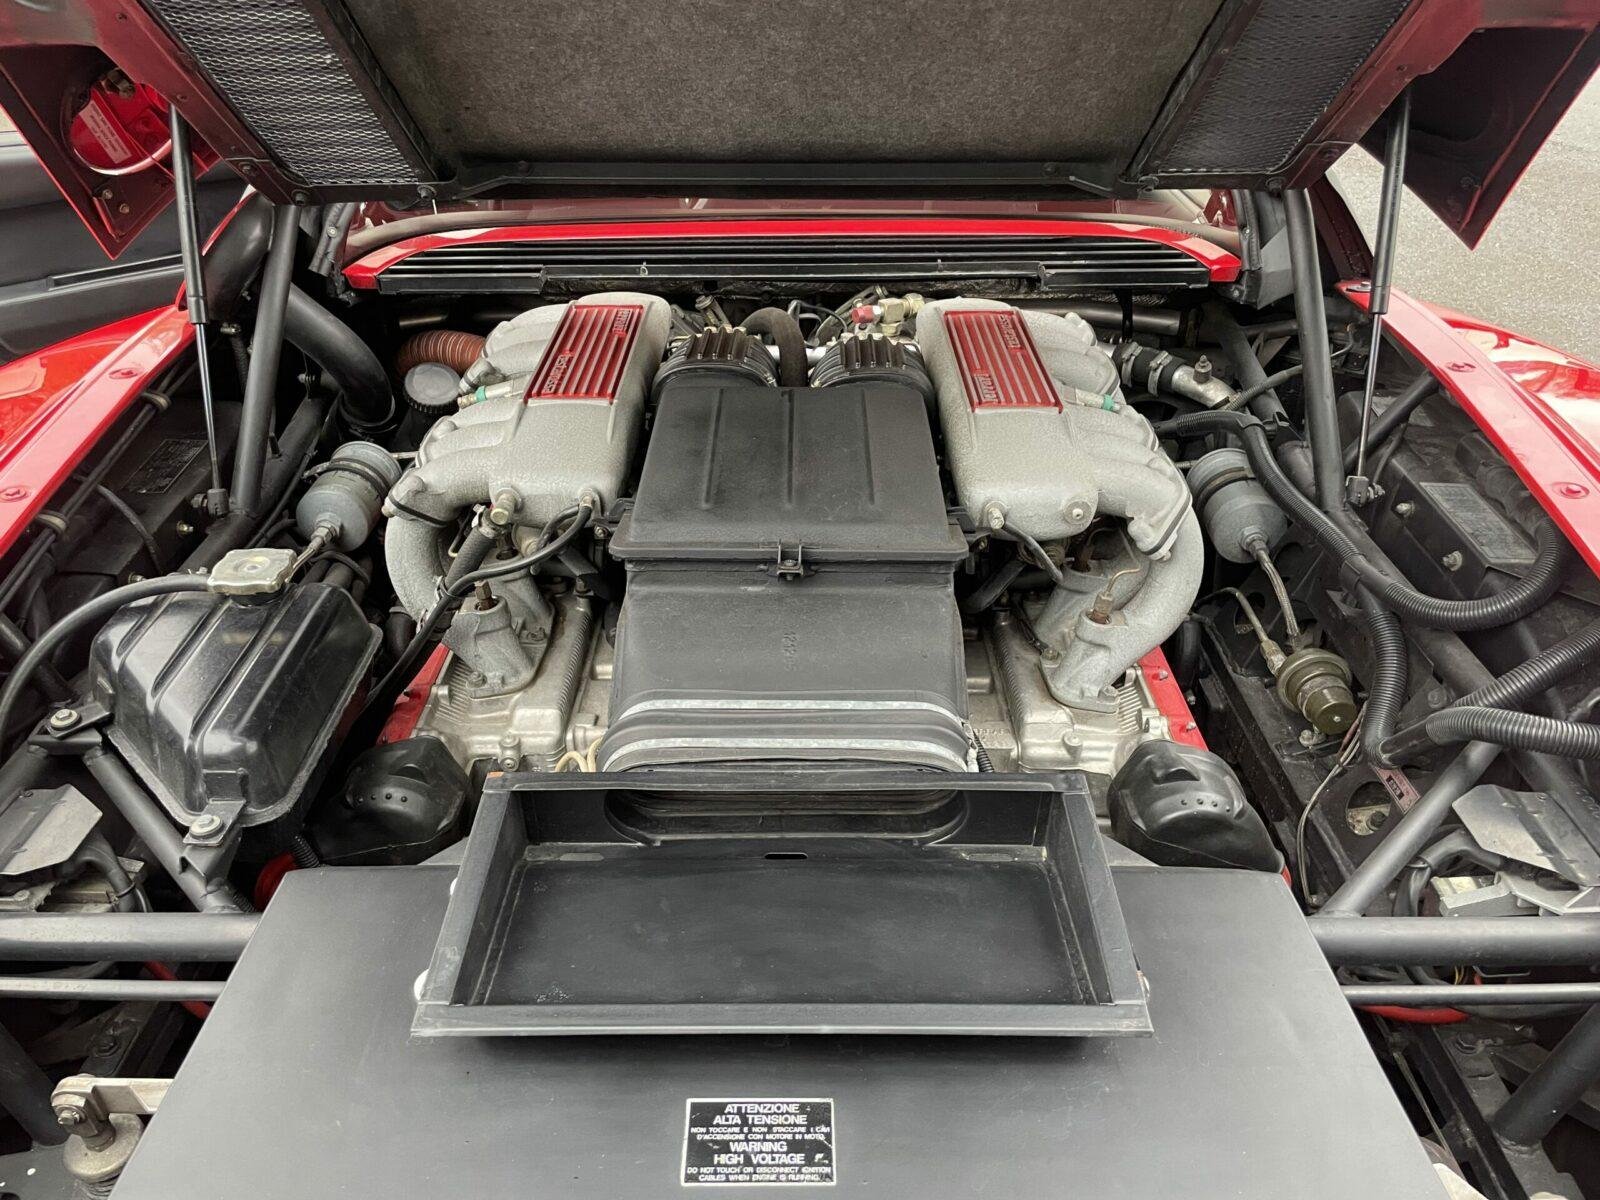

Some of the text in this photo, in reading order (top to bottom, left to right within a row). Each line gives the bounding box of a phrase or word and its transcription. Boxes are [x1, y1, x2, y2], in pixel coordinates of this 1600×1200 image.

[724, 1104, 800, 1113] ATTENZIONE
[713, 1115, 808, 1124] ALTA TENSIONE
[729, 1142, 788, 1152] WARNING
[713, 1154, 806, 1164] HIGH VOLTAGE
